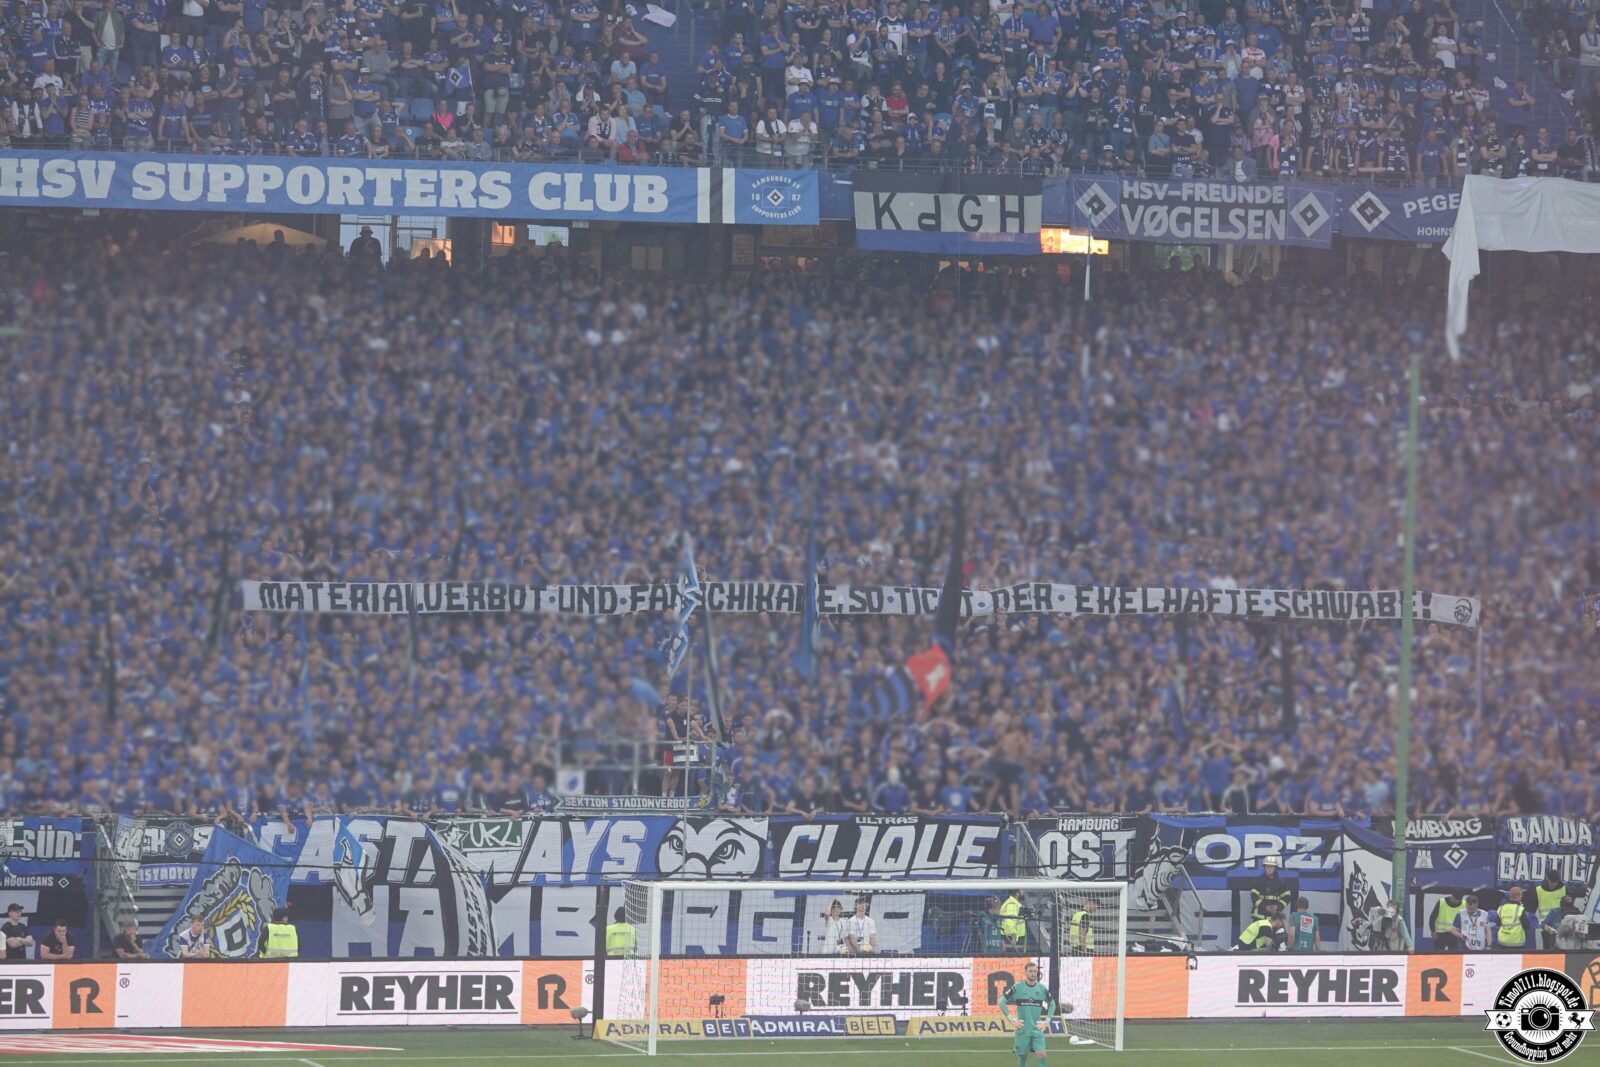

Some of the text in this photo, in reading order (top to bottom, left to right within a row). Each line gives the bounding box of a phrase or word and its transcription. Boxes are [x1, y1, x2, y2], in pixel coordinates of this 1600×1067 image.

[0, 157, 669, 213] HSV SUPPORTERS CLUB
[1122, 179, 1285, 204] HSV-FREUNDE
[1121, 203, 1286, 241] VØGELSEN
[893, 586, 974, 616] TICT
[564, 796, 692, 809] SEKTION STADIONVERBOT
[855, 816, 919, 825] ULTRAS
[1058, 817, 1120, 831] HAMBURG
[1391, 817, 1482, 838] AMBURG
[778, 823, 1001, 880] CLIQUE
[1038, 830, 1137, 880] OST
[3, 876, 54, 888] HOOLIGANS
[339, 975, 515, 1011] REYHER
[797, 971, 966, 1008] REYHER
[1237, 969, 1401, 1004] REYHER
[605, 1021, 749, 1037] ADMRAL BET
[750, 1017, 895, 1036] ADMIRAL BET
[919, 1019, 1015, 1034] ADMIRAL
